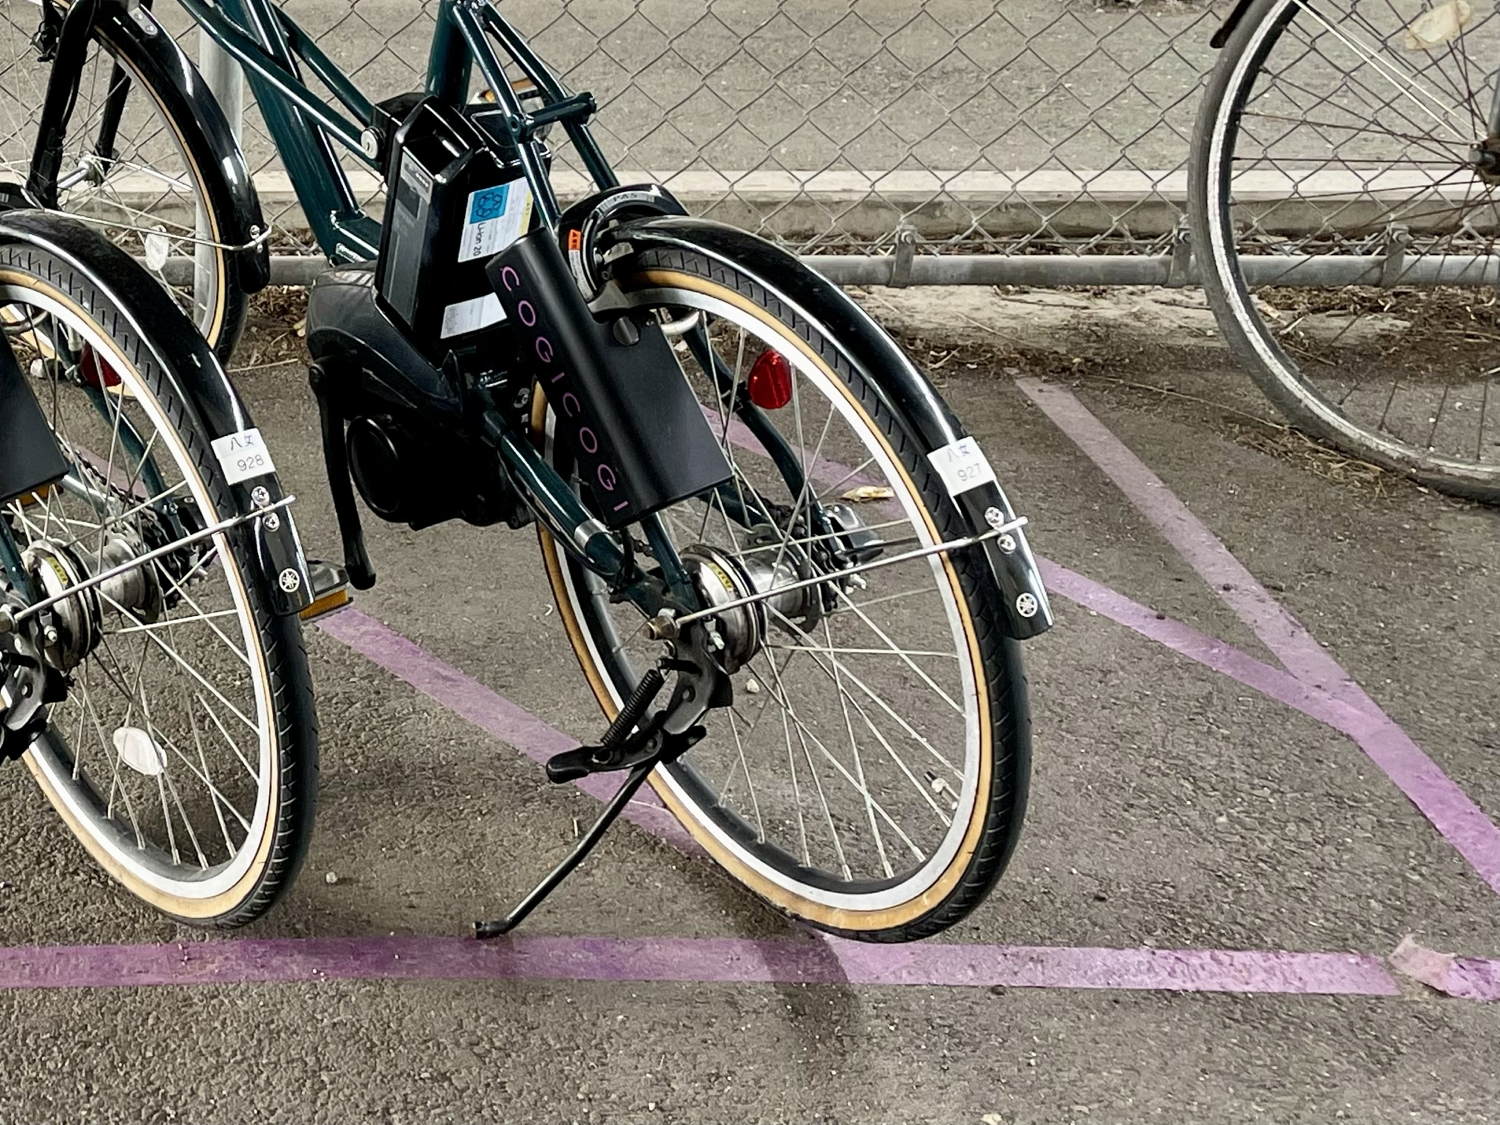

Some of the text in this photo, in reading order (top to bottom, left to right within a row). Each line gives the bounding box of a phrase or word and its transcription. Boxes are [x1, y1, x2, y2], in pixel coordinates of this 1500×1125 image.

[613, 193, 639, 203] PAS
[500, 266, 629, 512] COGICOGI
[236, 453, 265, 472] 928
[957, 462, 982, 482] 927
